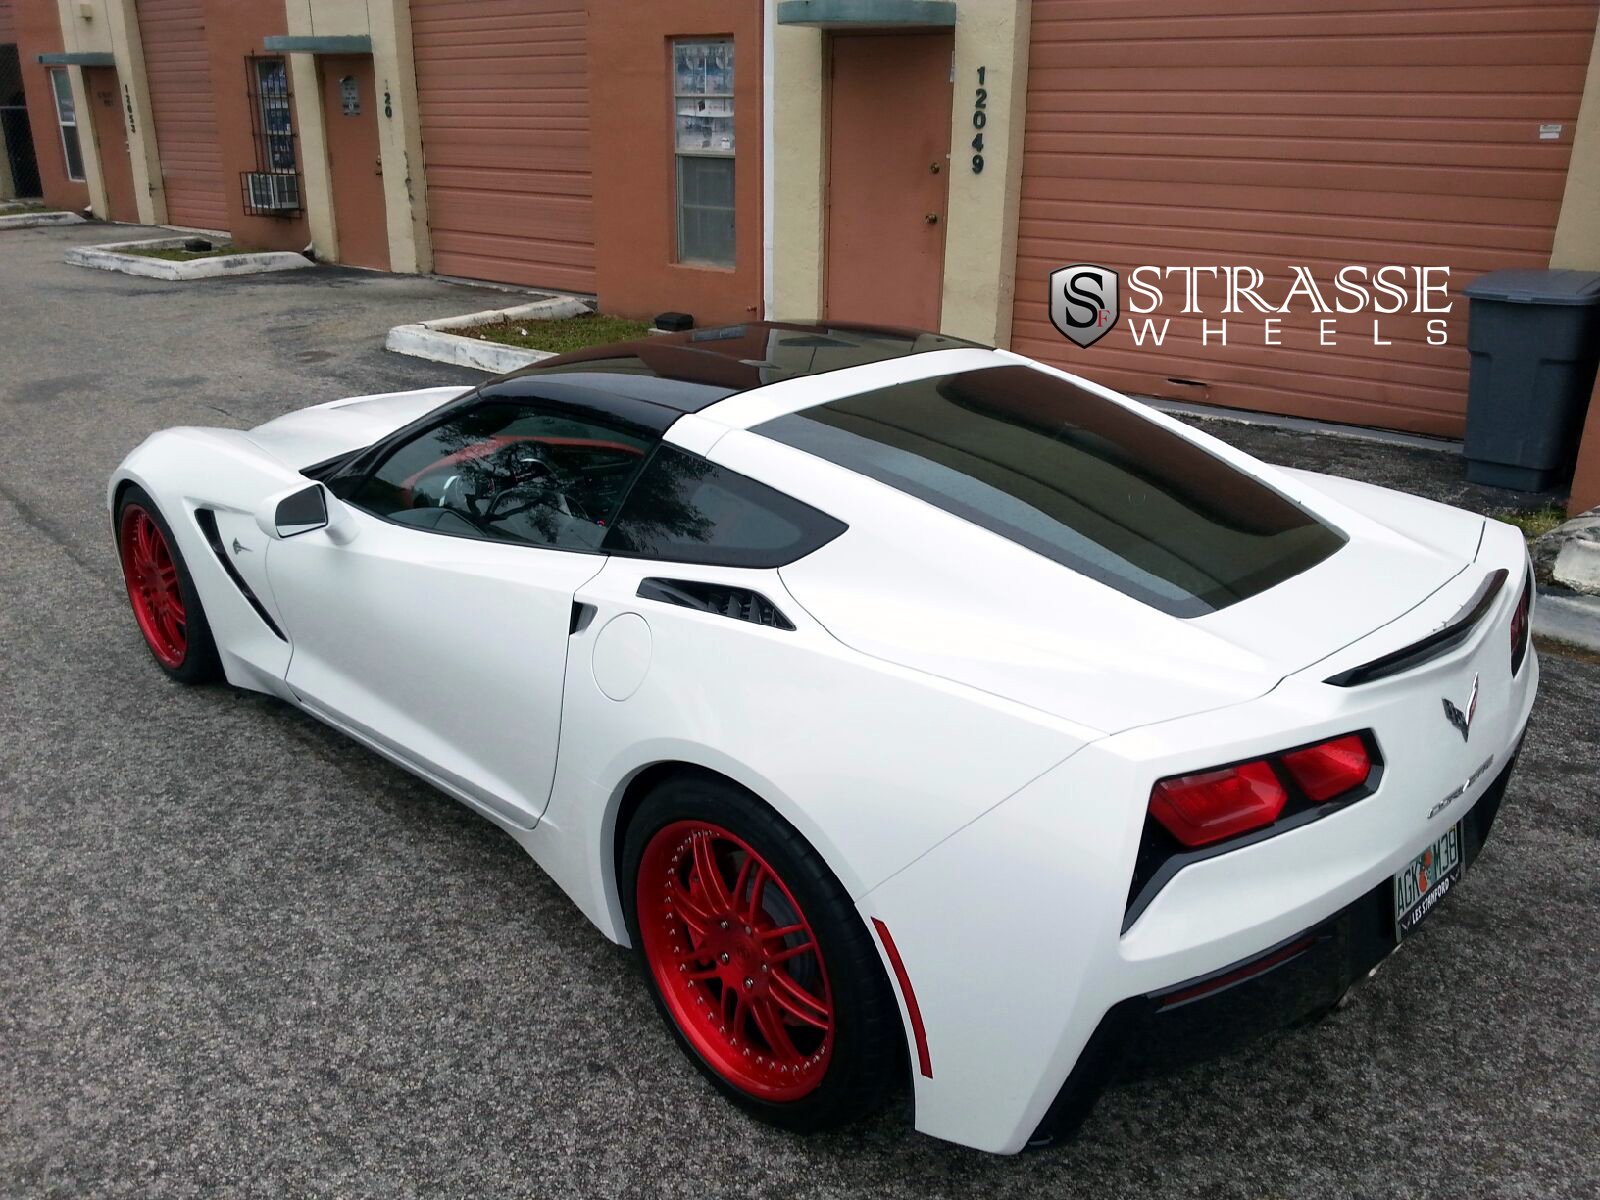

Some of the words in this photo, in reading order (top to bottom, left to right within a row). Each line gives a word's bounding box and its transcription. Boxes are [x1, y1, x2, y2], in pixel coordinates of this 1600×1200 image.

[972, 66, 987, 174] 12049
[1397, 860, 1421, 918] AGK
[1433, 828, 1457, 878] M38
[1411, 904, 1422, 925] LES
[1422, 877, 1450, 914] STANFORD
